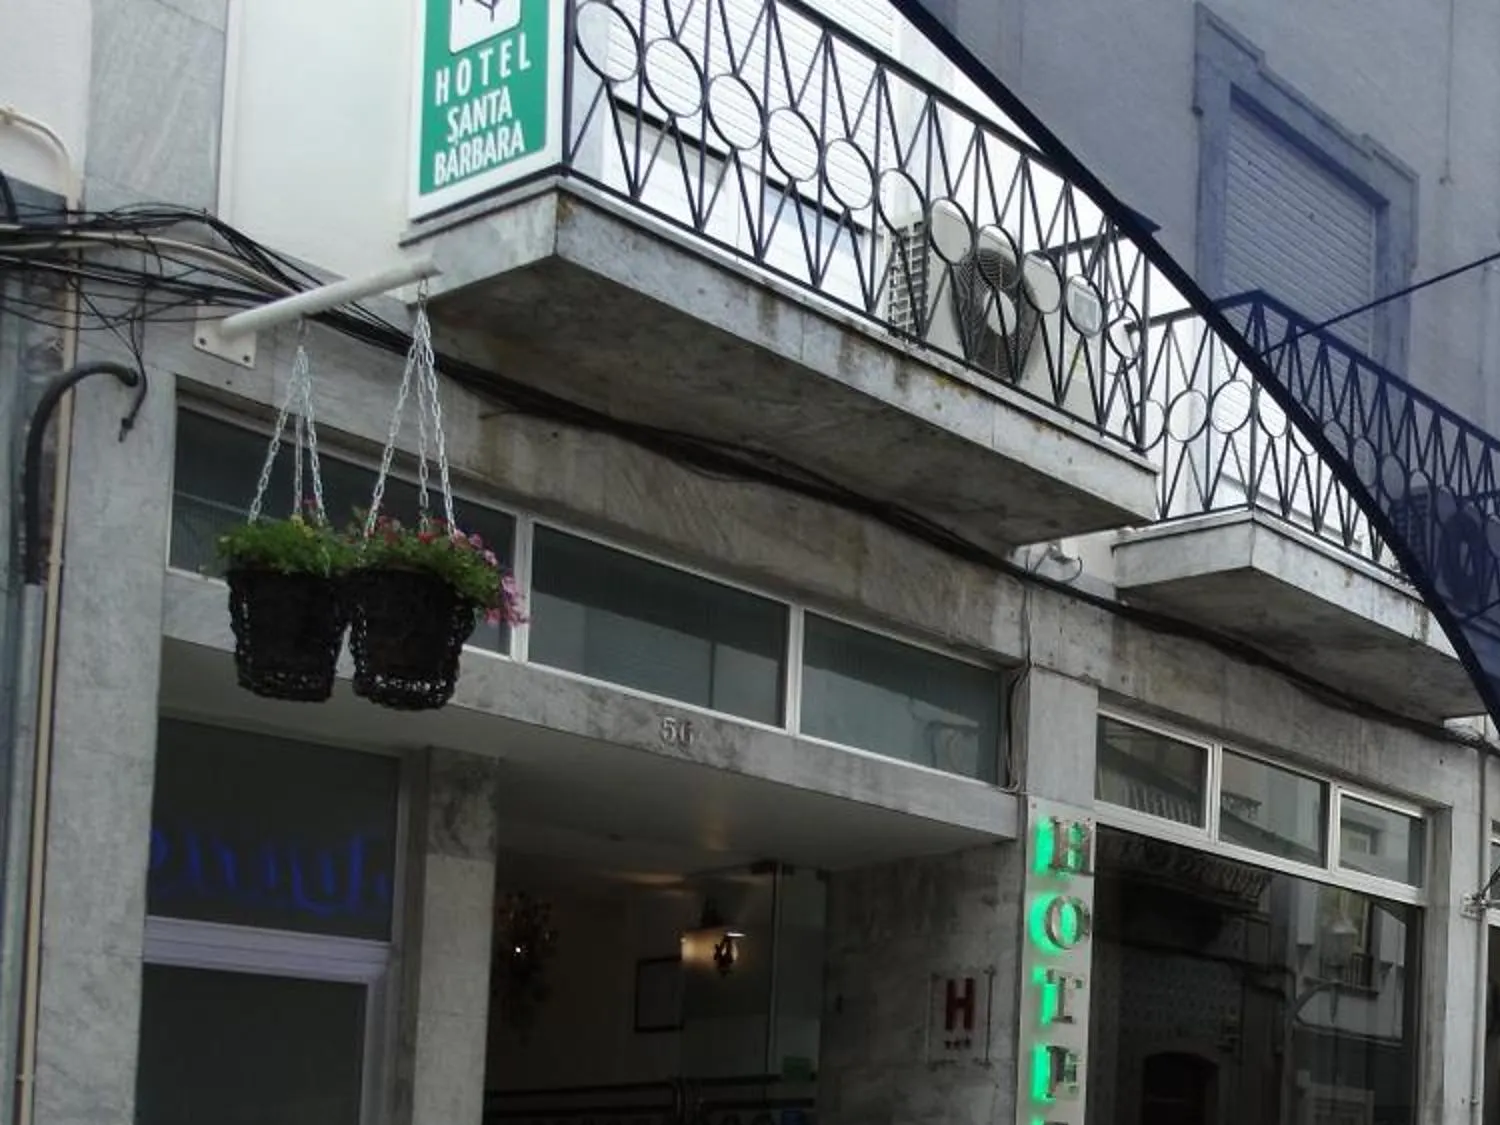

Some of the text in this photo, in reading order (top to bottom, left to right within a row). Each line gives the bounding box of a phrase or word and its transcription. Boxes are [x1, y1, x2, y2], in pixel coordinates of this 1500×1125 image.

[435, 32, 532, 107] HOTEL
[446, 84, 513, 144] SANTA
[945, 977, 975, 1031] H
